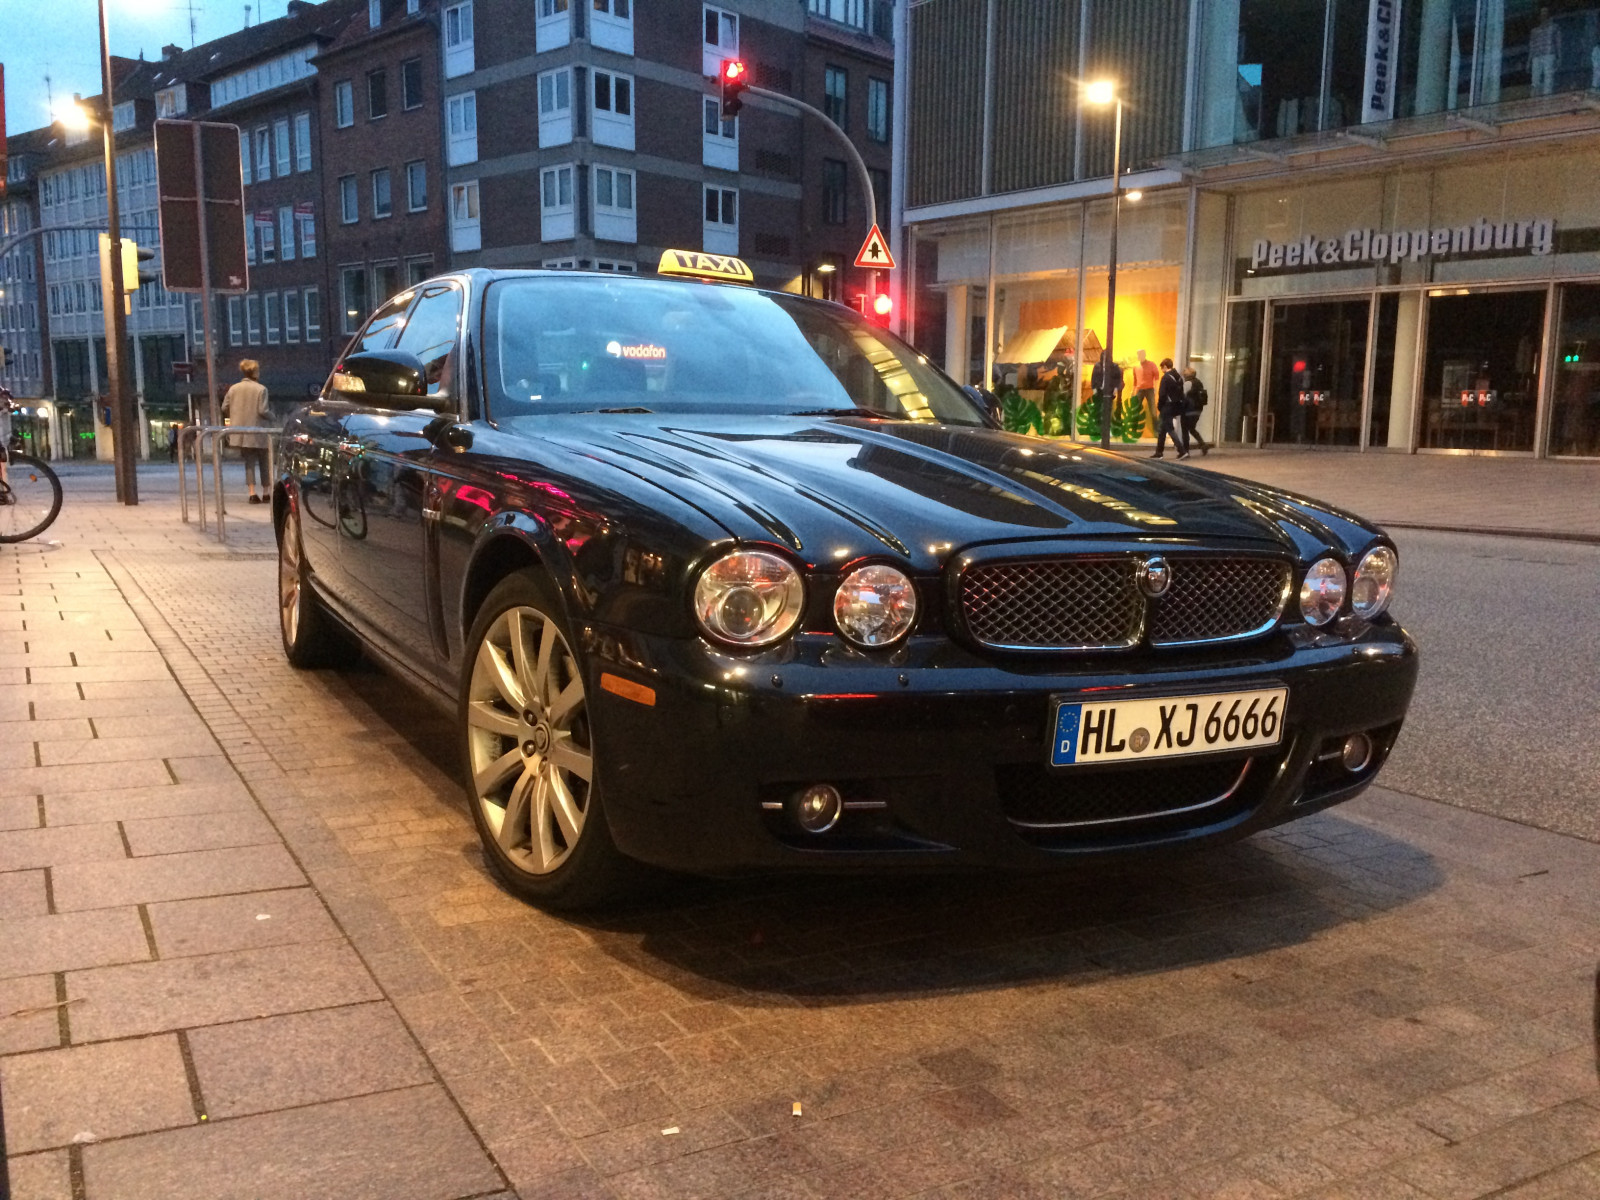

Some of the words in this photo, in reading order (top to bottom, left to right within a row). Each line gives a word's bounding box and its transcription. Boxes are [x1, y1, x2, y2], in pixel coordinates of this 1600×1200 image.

[1252, 217, 1555, 269] Peek&Cloppenburg
[674, 252, 745, 275] TAXI
[1080, 708, 1126, 755] HL
[1153, 703, 1198, 750] XJ
[1204, 696, 1279, 744] 6666
[1060, 739, 1070, 753] D
